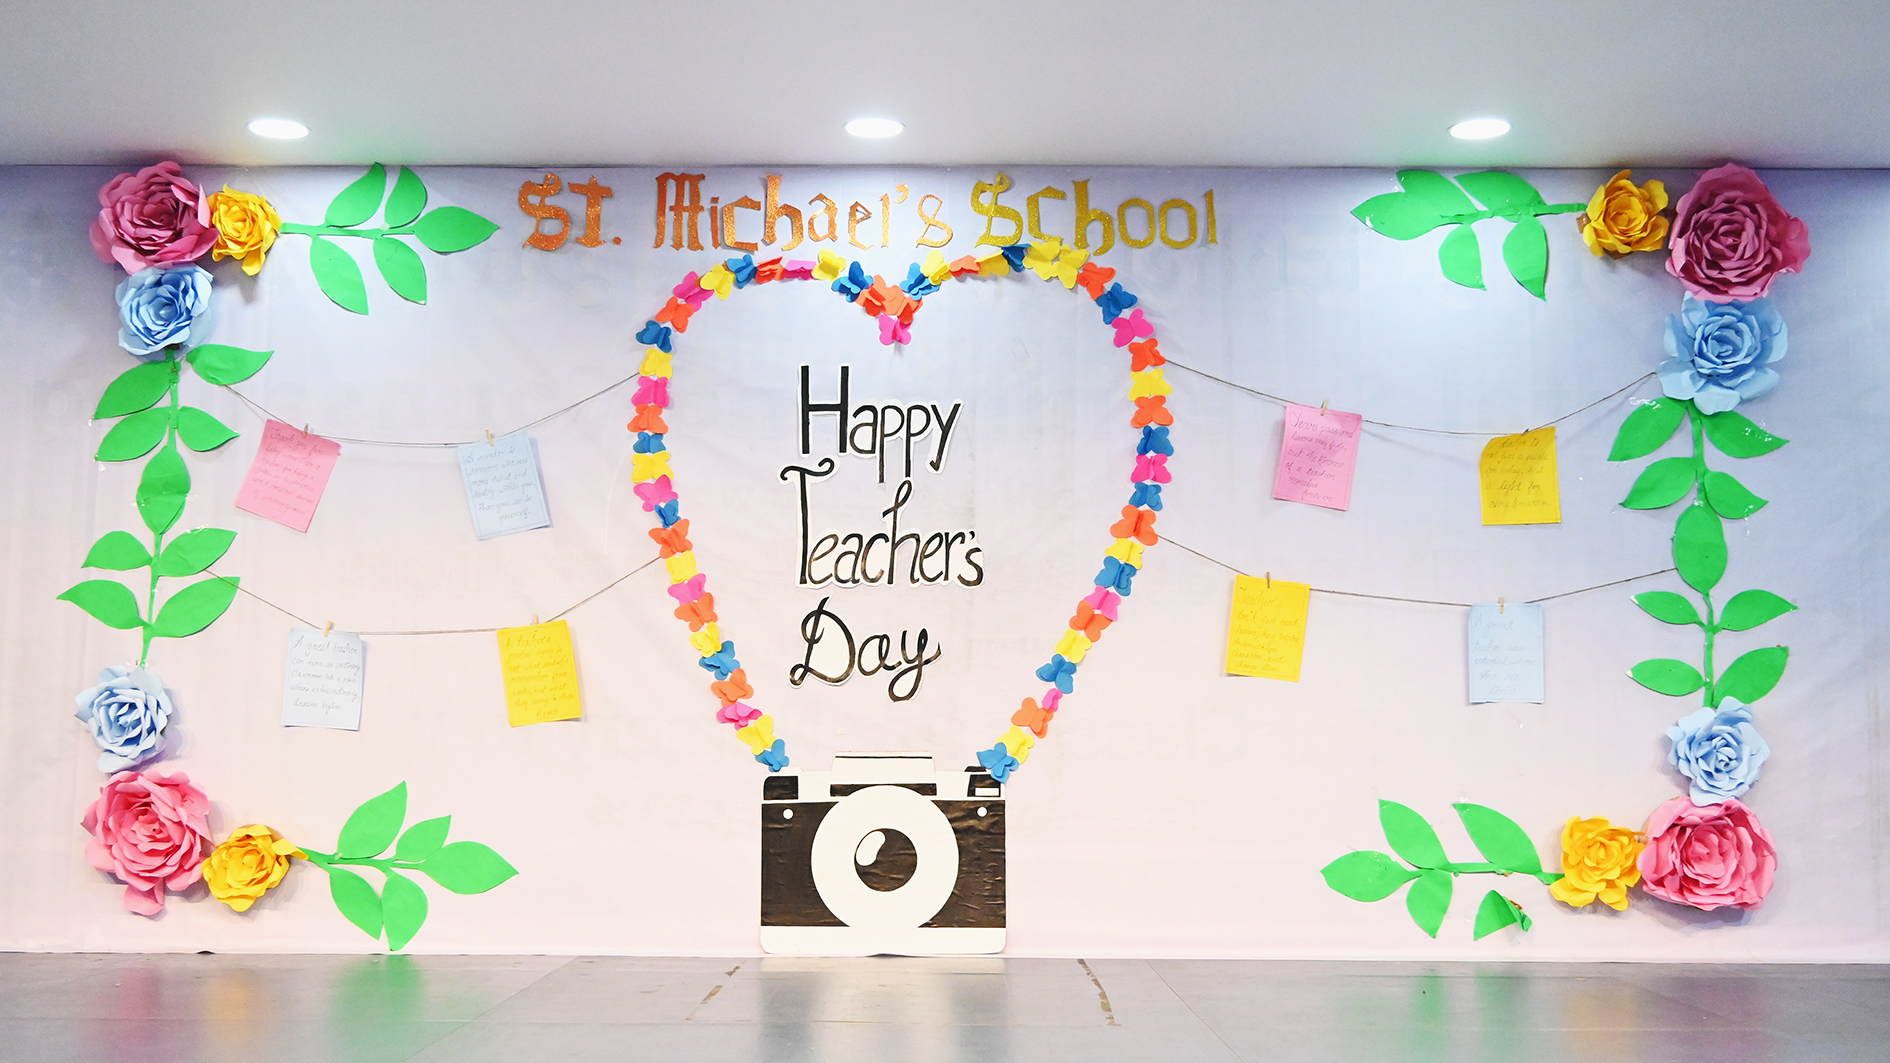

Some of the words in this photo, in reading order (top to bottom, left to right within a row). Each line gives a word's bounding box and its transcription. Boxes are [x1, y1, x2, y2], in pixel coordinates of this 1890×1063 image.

[653, 172, 954, 252] Michael's
[972, 172, 1219, 256] School
[800, 364, 962, 484] Happy
[779, 457, 984, 587] Teacher's
[789, 596, 943, 703] Day
